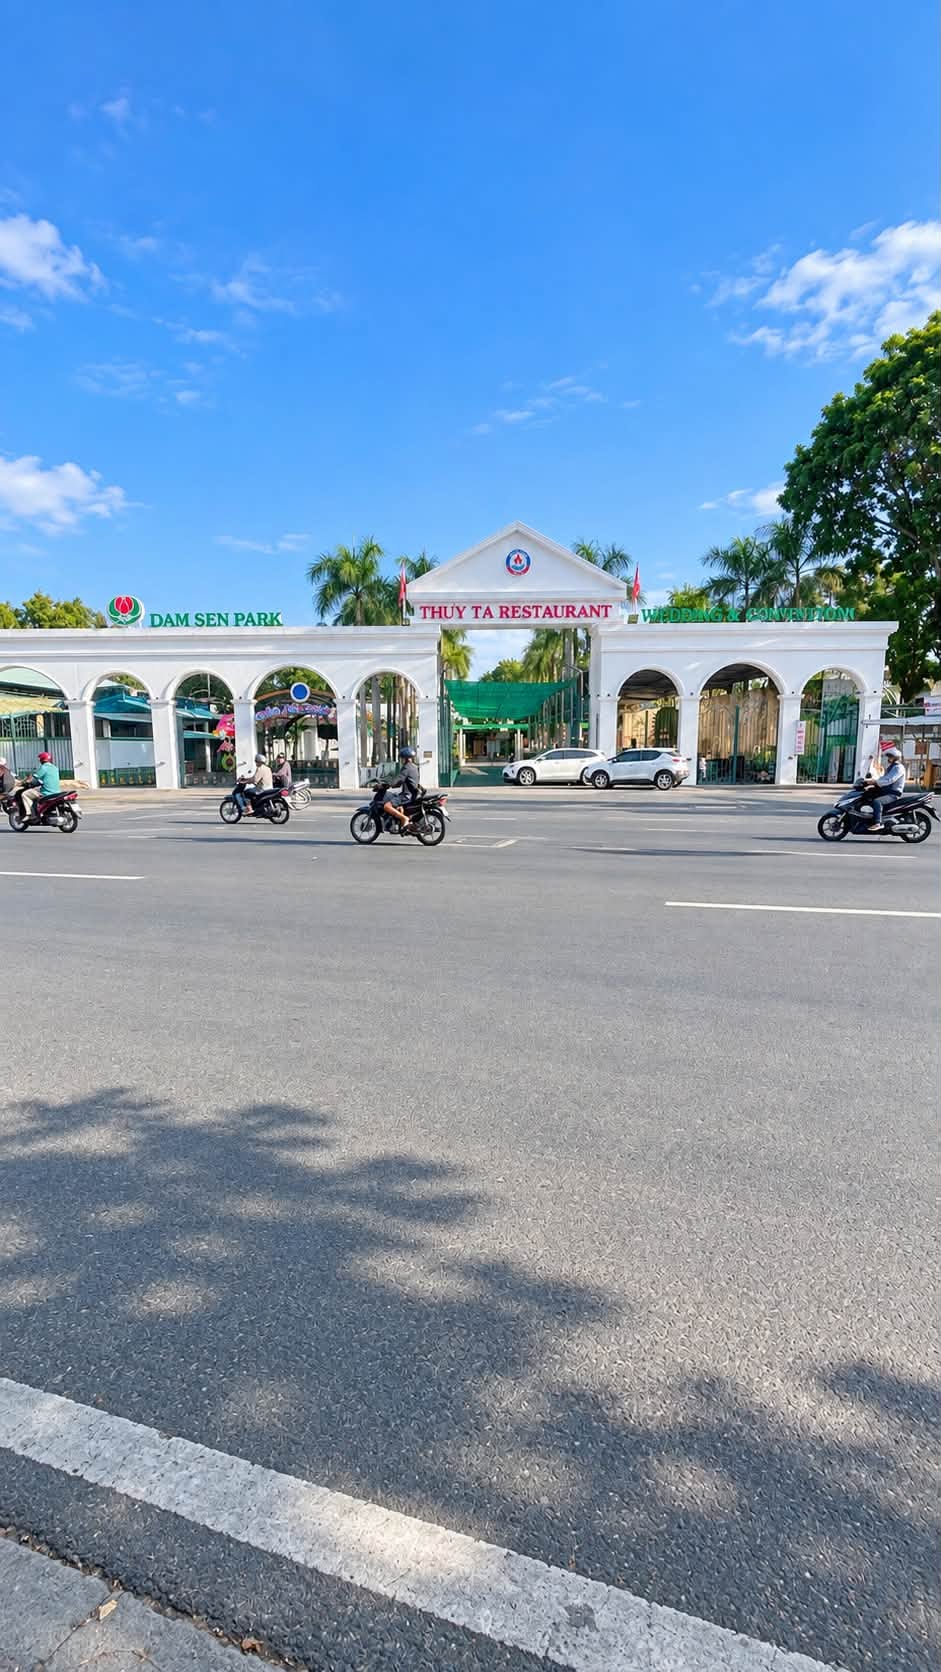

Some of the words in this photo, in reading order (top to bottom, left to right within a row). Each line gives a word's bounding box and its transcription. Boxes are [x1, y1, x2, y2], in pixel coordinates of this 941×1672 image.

[471, 605, 494, 619] TA
[498, 604, 612, 619] RESTAURANT
[150, 613, 189, 627] DAM
[194, 613, 228, 627] SEN
[234, 612, 283, 627] PARK
